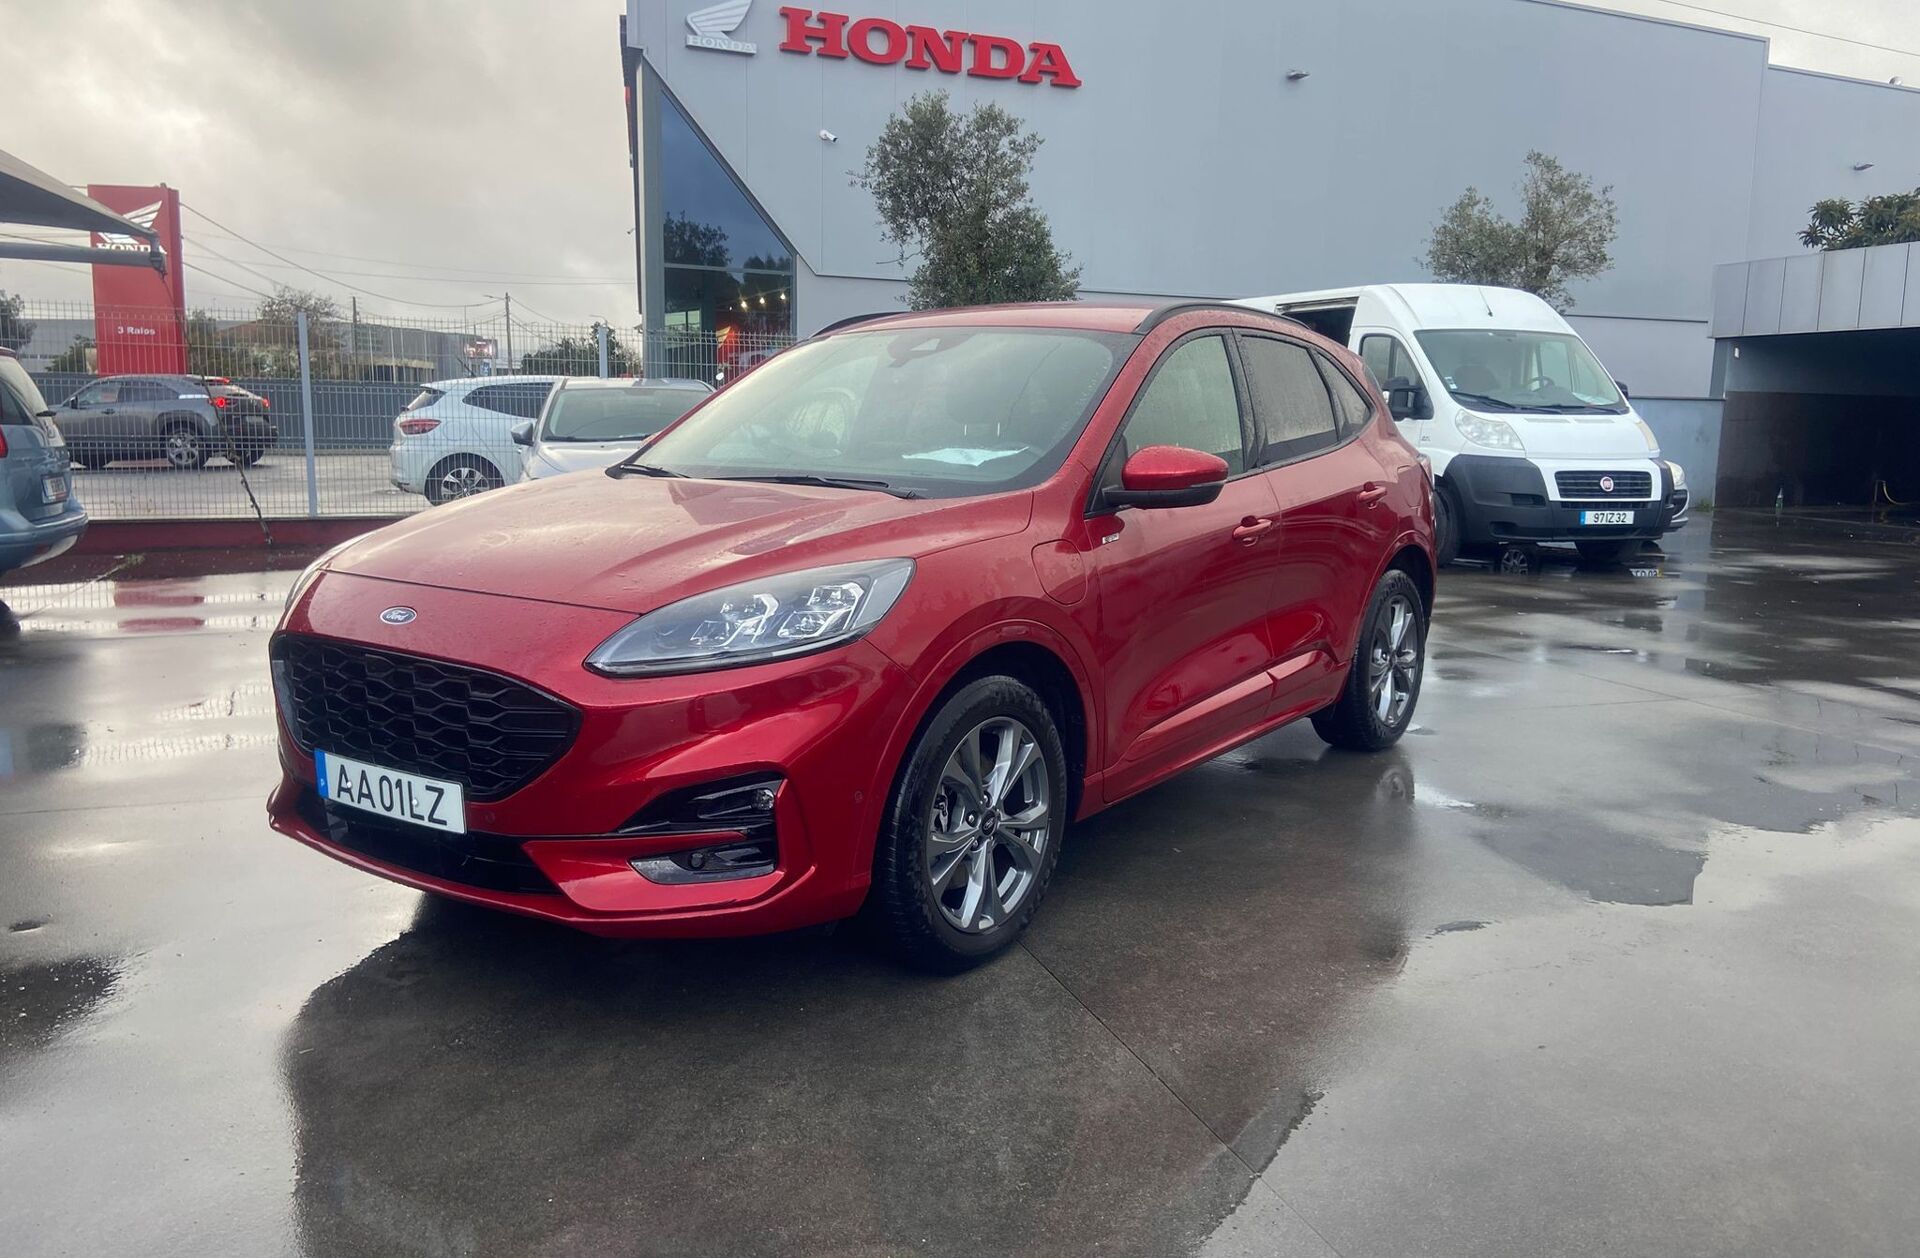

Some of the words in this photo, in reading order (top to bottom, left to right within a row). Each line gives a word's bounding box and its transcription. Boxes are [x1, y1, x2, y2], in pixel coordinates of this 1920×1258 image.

[687, 35, 756, 54] HONDA
[779, 6, 1082, 88] HONDA
[117, 326, 124, 334] 3
[337, 764, 447, 826] AA01LZ
